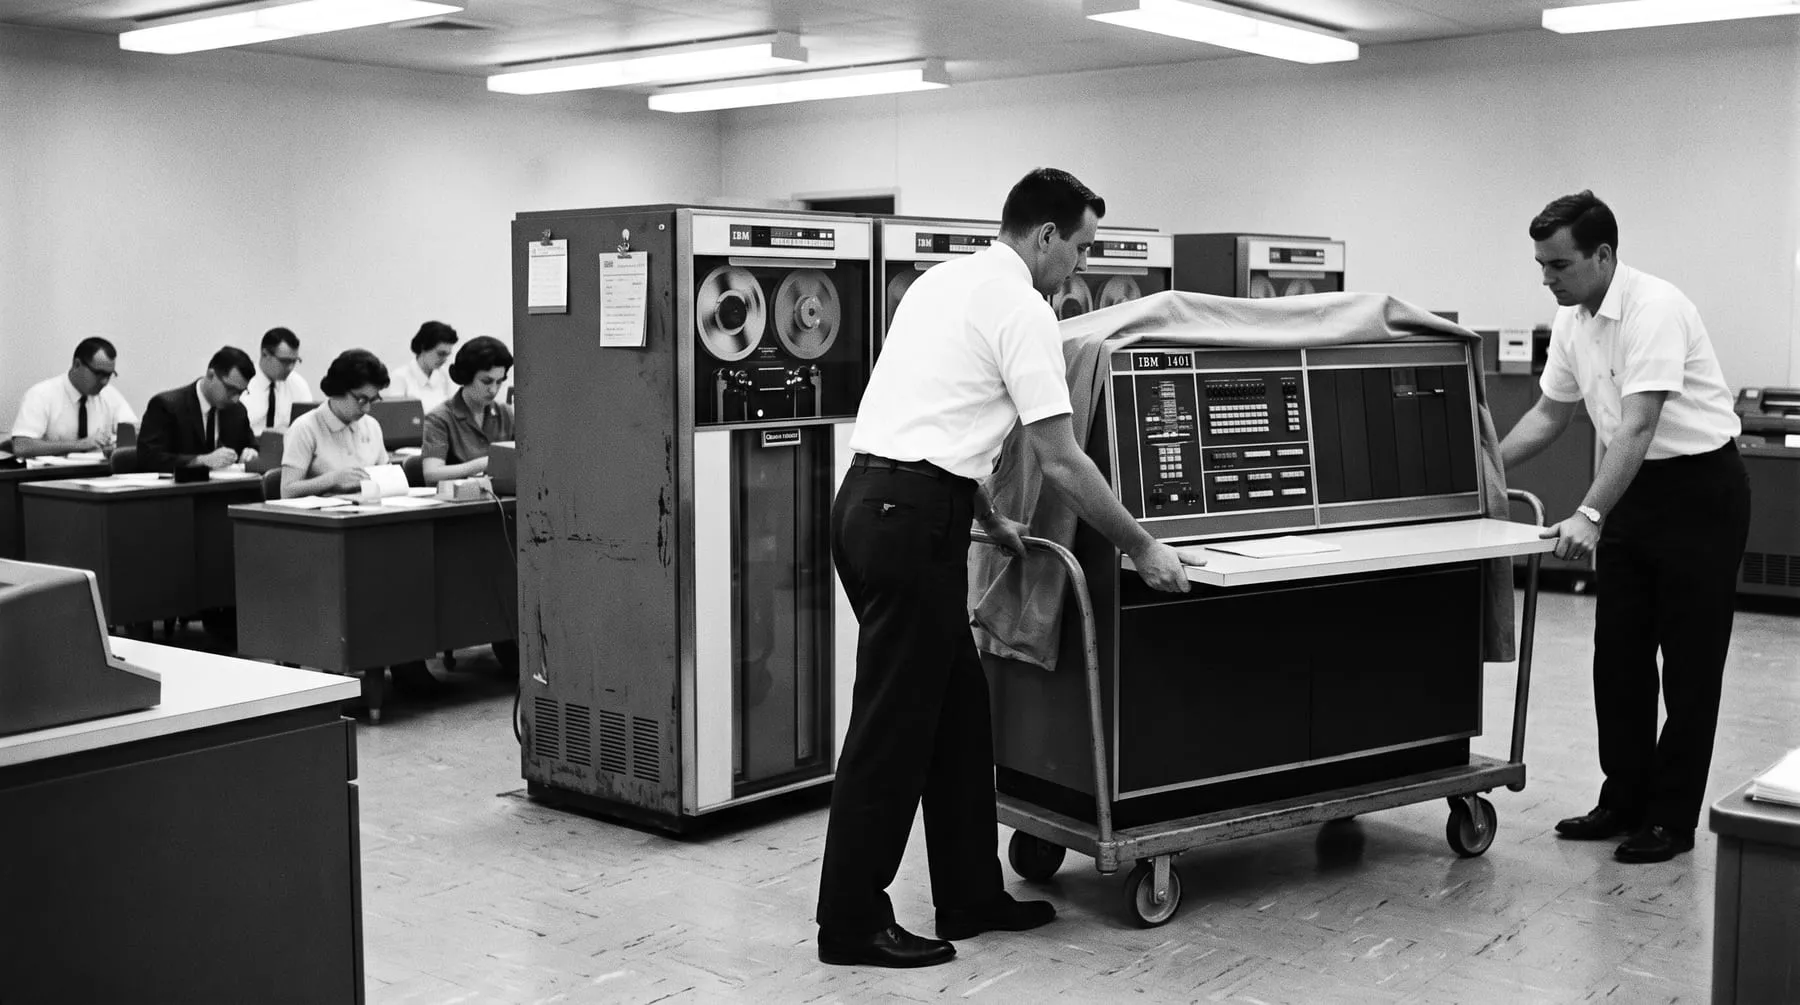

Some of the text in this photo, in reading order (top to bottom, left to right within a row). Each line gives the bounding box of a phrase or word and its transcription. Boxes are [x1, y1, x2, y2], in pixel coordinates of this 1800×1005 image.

[732, 231, 750, 240] IBM
[917, 238, 932, 248] IBM
[1138, 355, 1189, 367] IBM 1401
